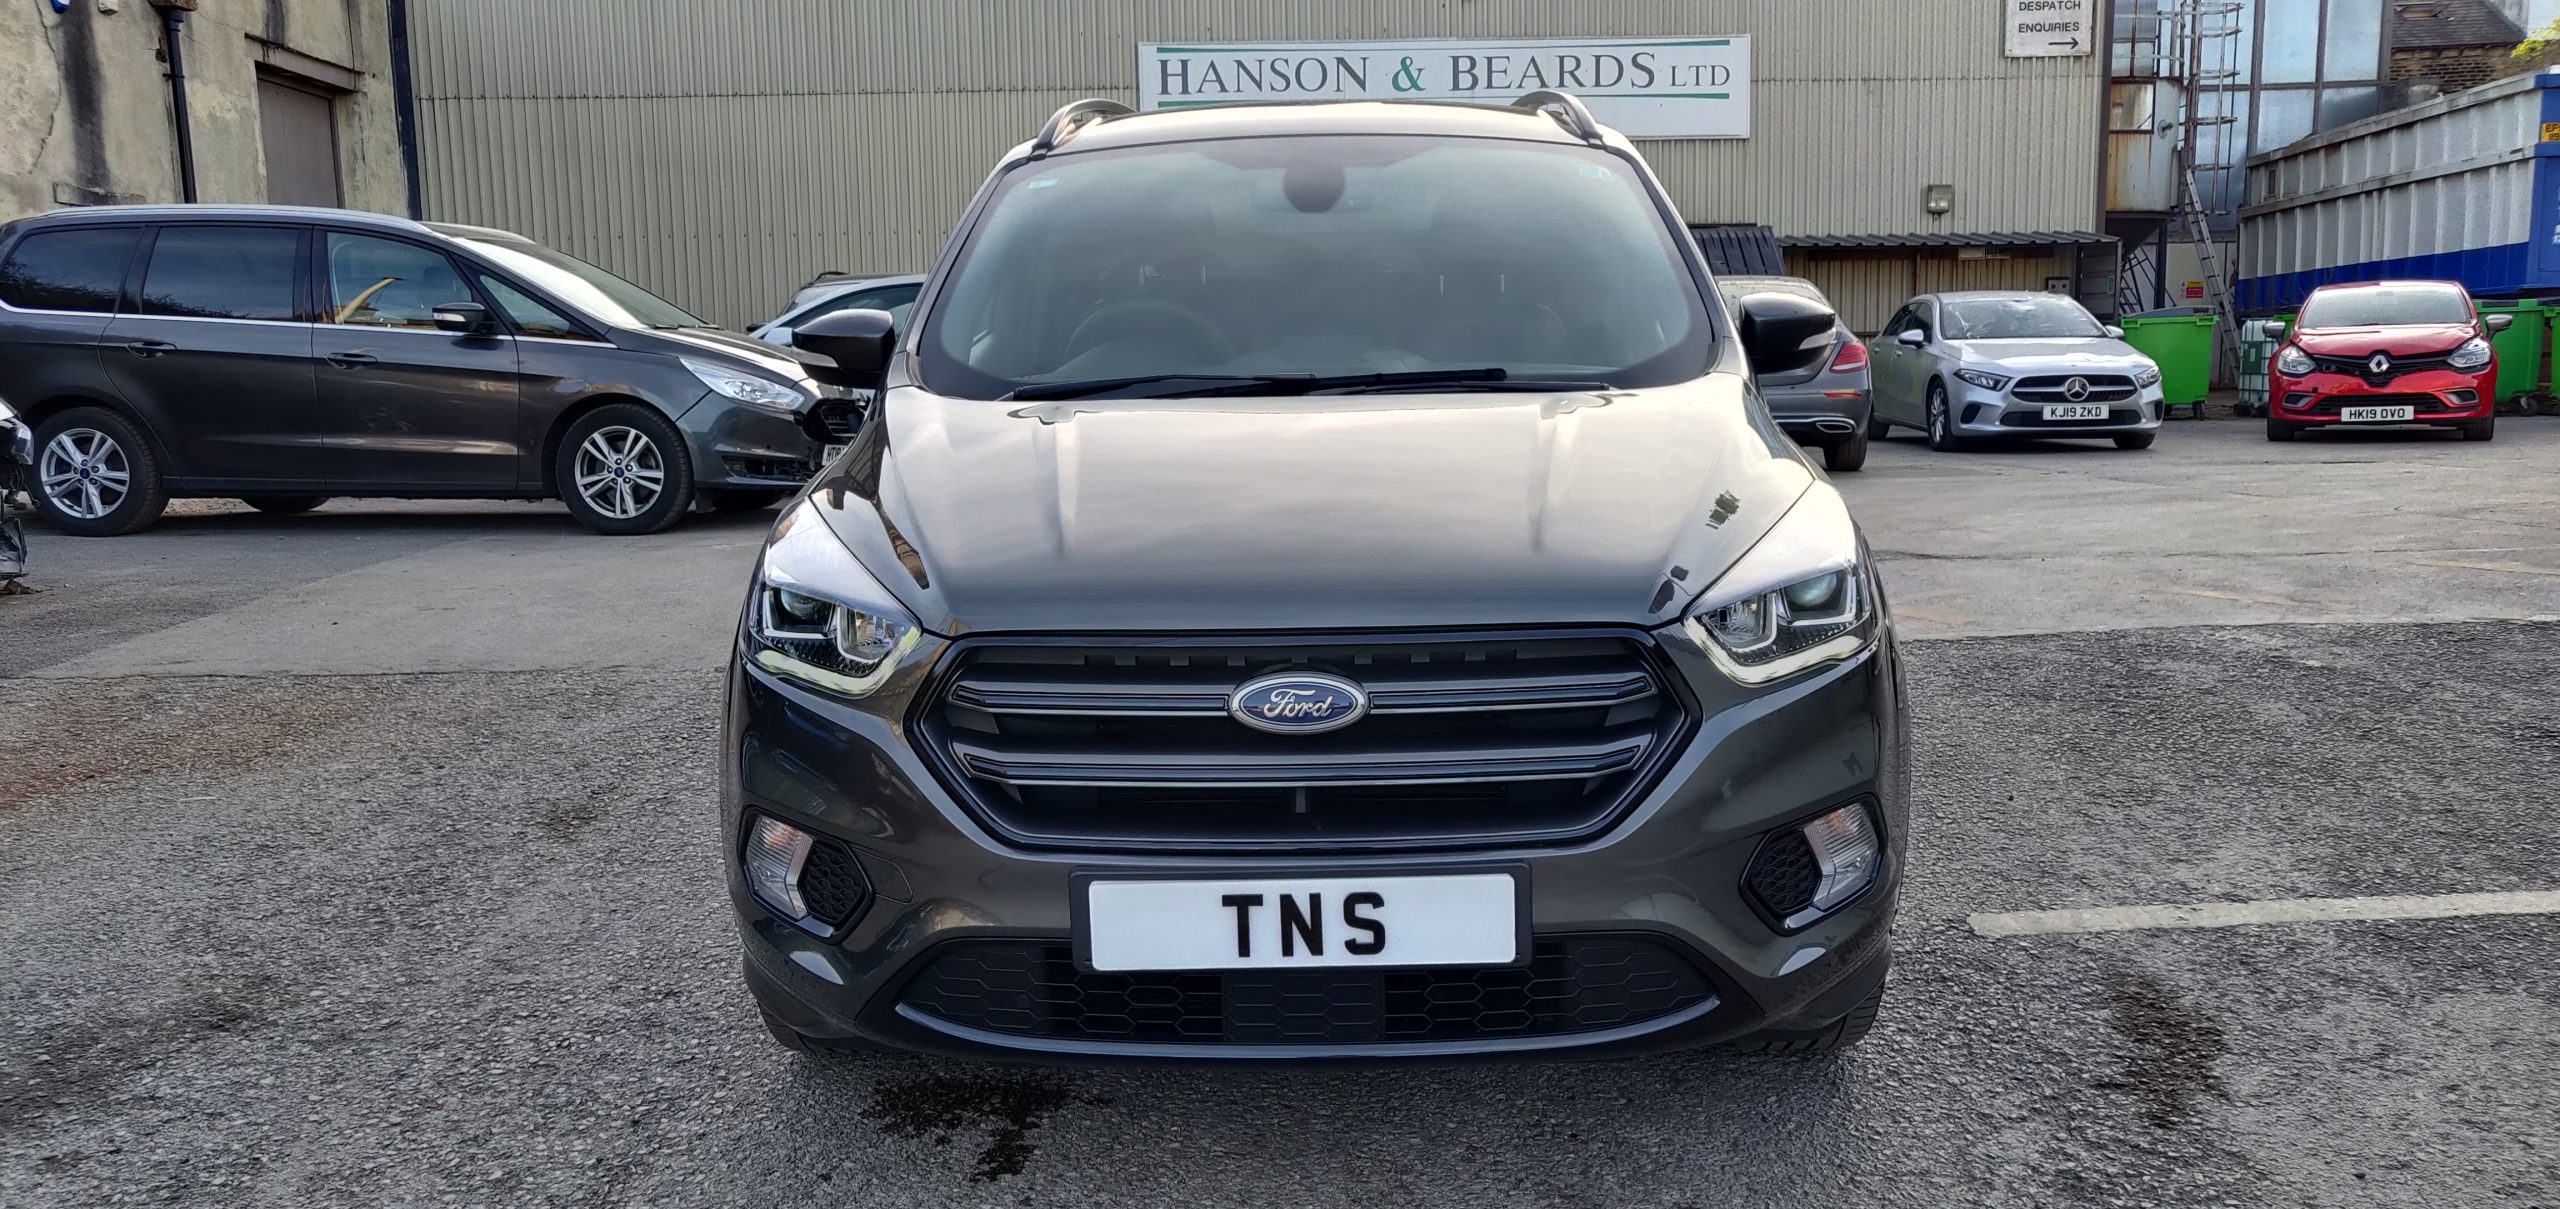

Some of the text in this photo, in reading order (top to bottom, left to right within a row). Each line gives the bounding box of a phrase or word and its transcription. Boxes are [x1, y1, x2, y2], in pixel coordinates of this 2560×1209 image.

[2018, 0, 2081, 11] DESPATCH
[2018, 22, 2080, 33] ENQUIRIES
[1157, 52, 1731, 96] HANSON & BEARDS LTD
[2050, 406, 2102, 418] KJ19 ZKD
[2349, 408, 2377, 420] HK19
[1263, 688, 1334, 718] Ford
[1221, 891, 1386, 958] TNS
